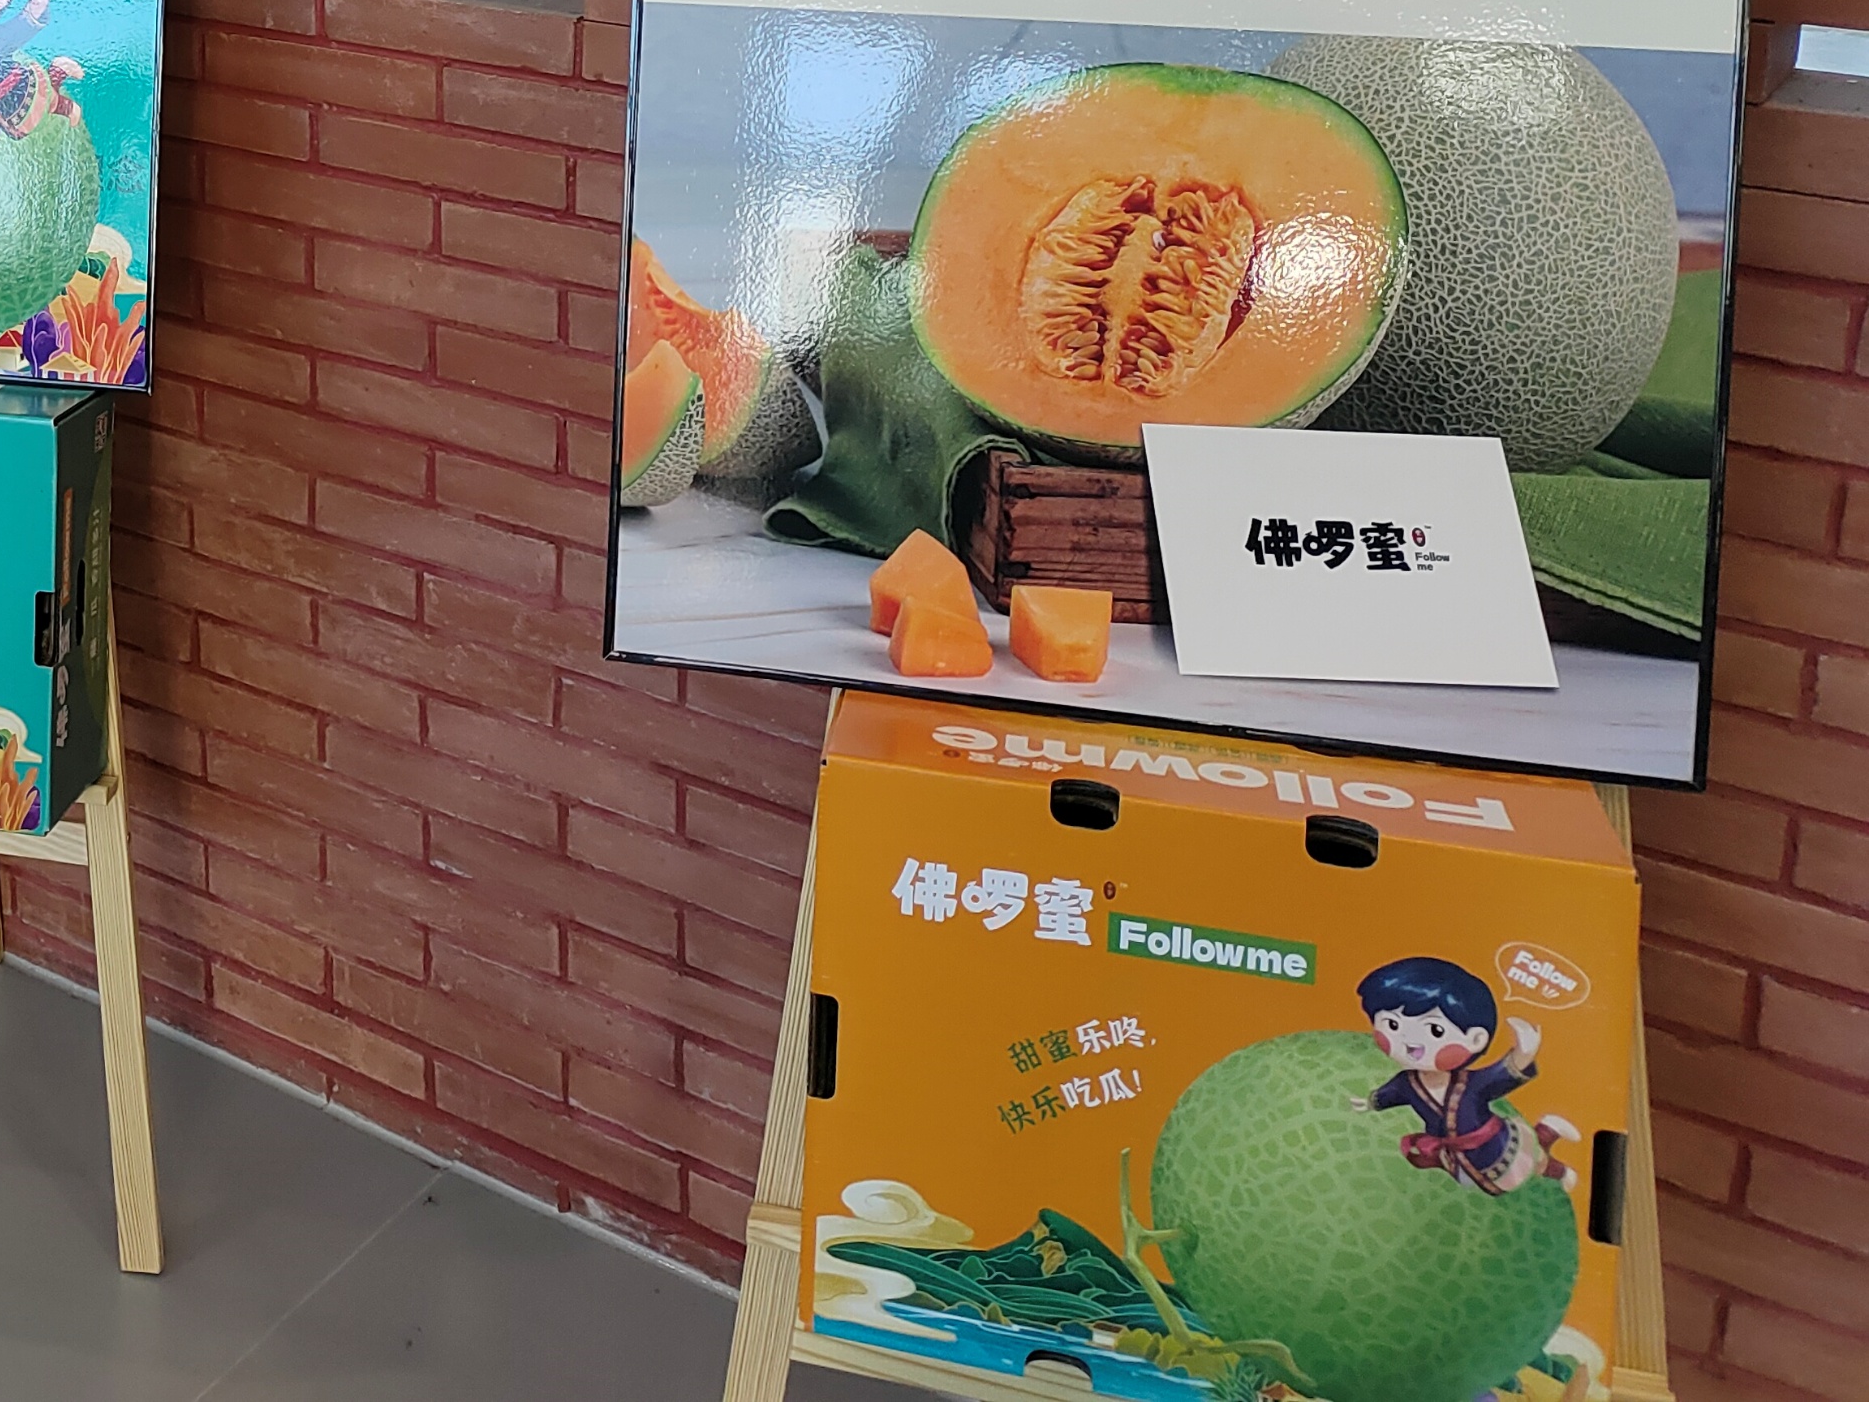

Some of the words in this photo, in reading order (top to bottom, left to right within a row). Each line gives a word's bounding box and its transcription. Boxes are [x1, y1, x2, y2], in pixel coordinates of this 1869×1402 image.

[931, 725, 1517, 833] Followme
[1119, 919, 1308, 978] Followme
[1507, 966, 1539, 989] me
[1514, 950, 1578, 991] Follow
[998, 1068, 1143, 1135] 快乐吃瓜!
